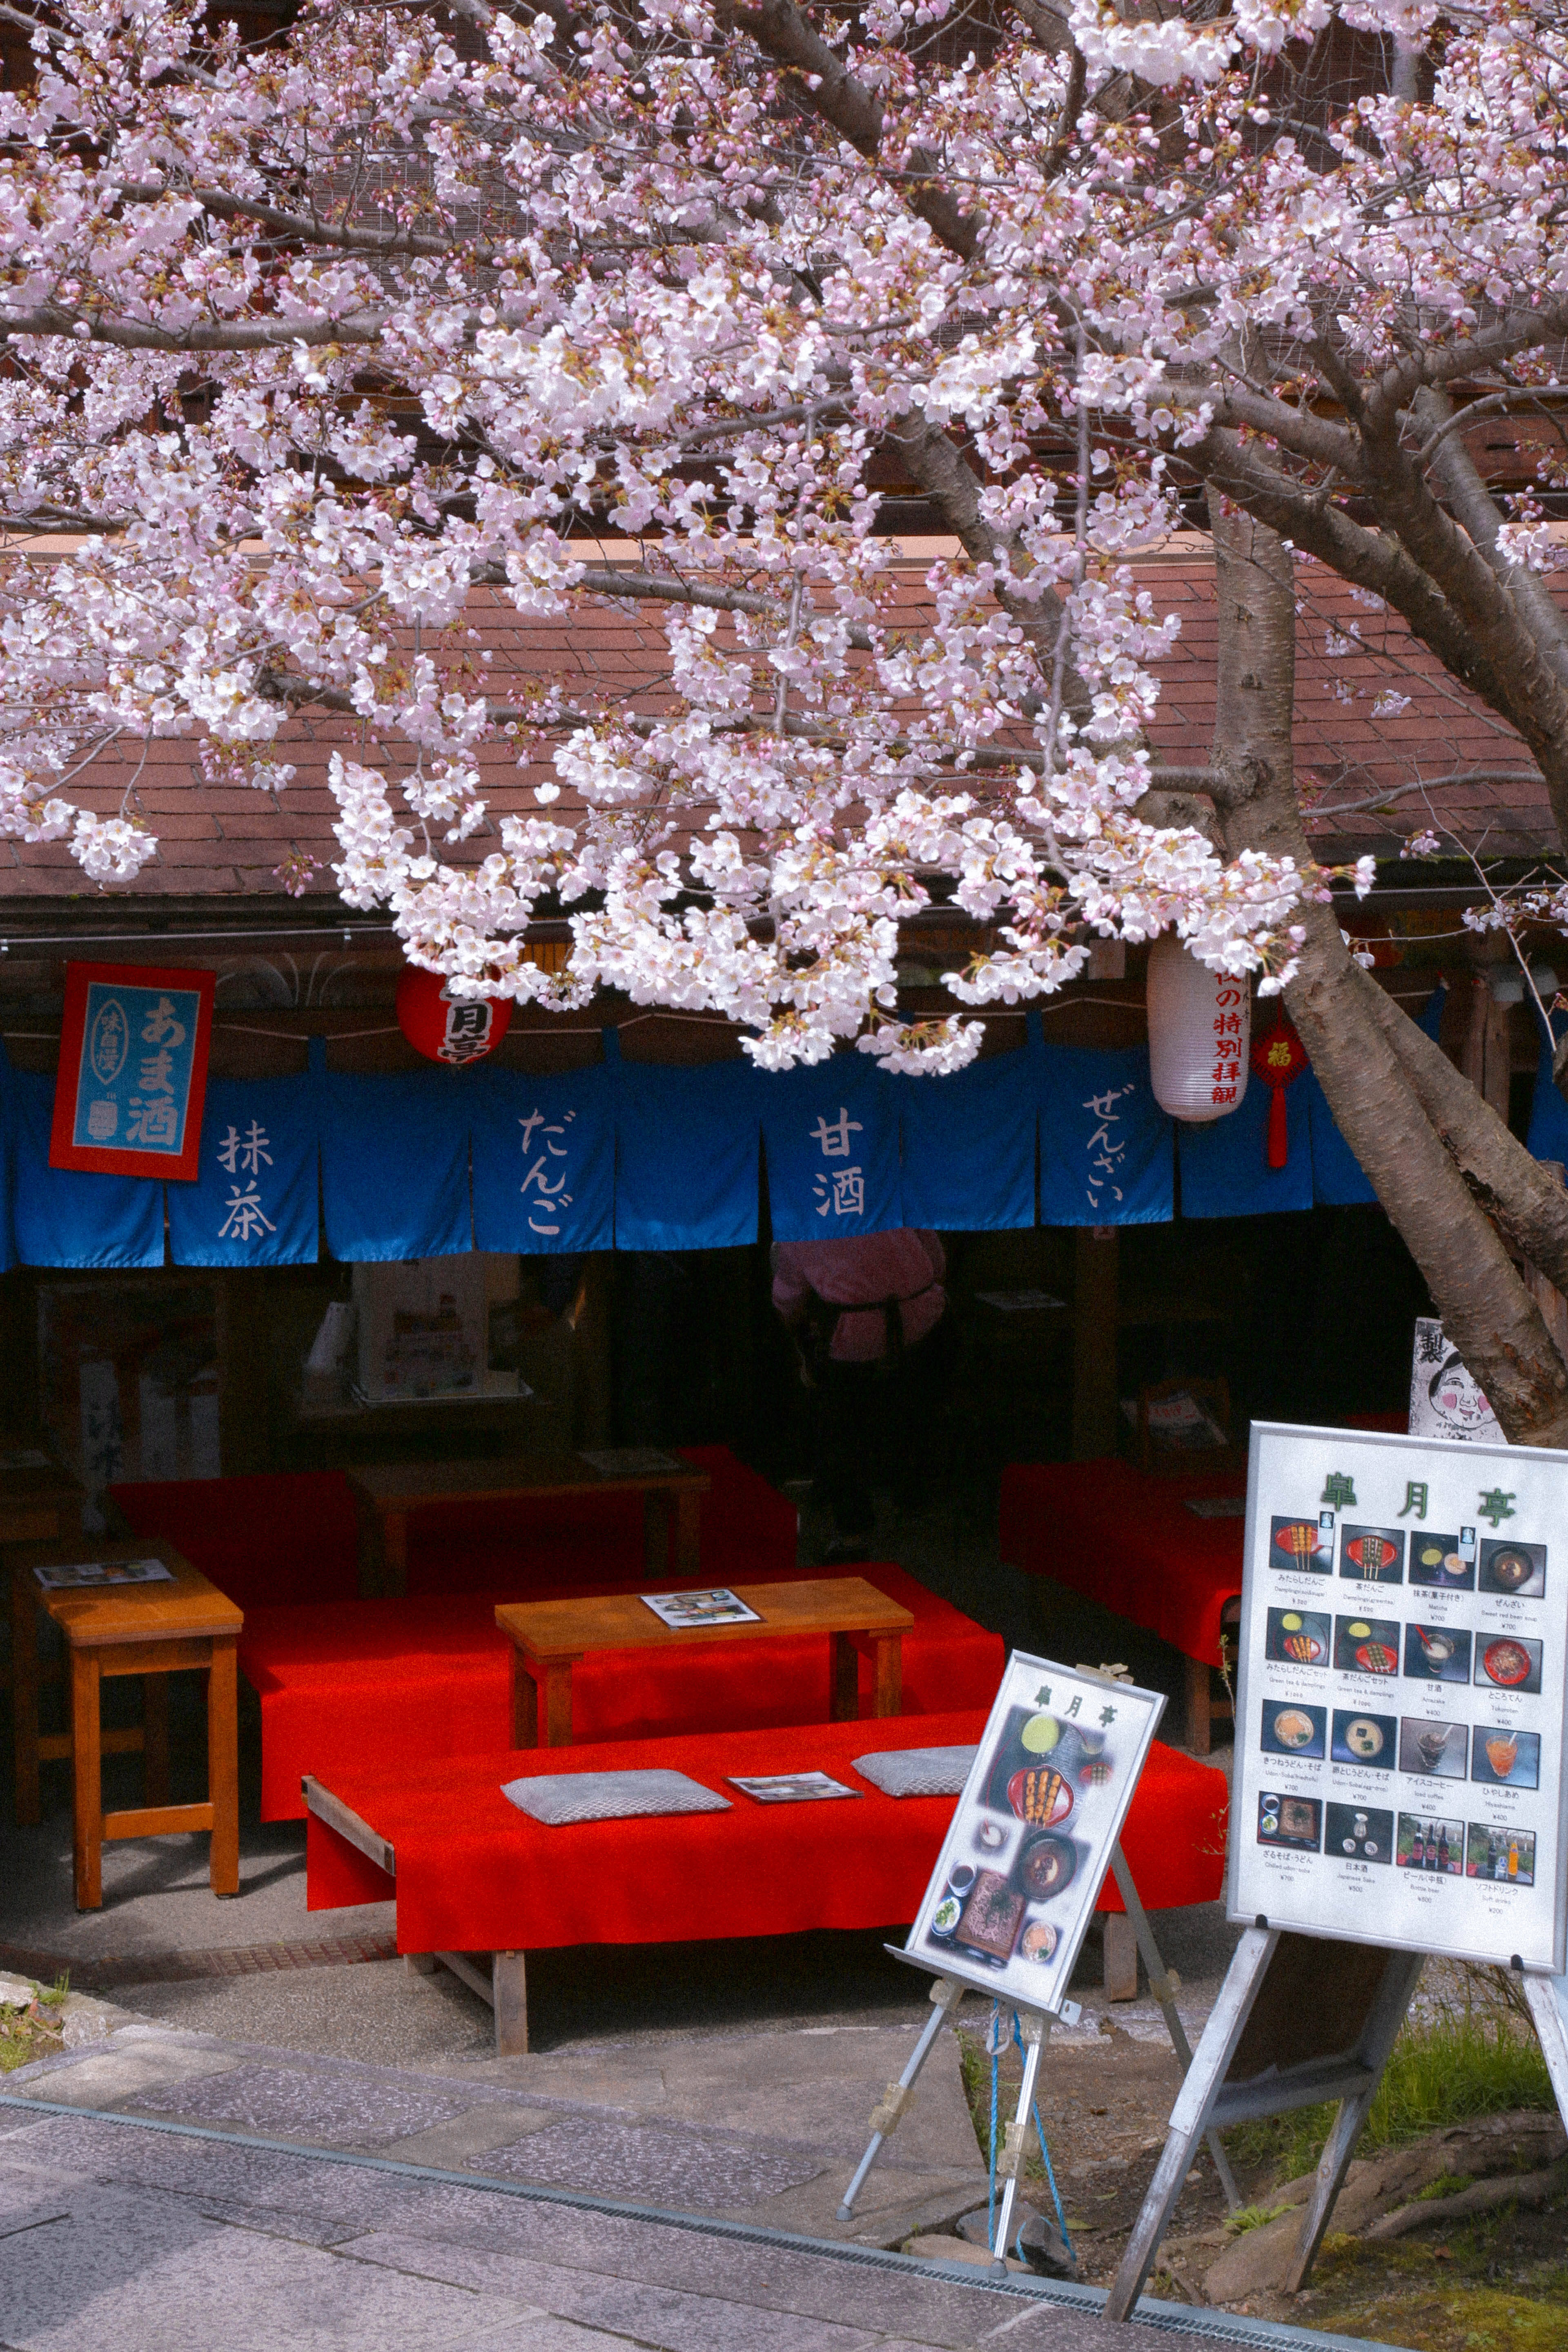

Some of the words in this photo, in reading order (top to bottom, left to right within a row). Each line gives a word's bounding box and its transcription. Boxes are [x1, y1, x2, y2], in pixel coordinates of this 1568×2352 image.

[441, 993, 488, 1062] 月亭
[96, 1011, 122, 1071] 味自慢
[1267, 1041, 1292, 1067] 福
[126, 997, 186, 1146] あま酒
[1082, 1083, 1135, 1208] ぜんざい
[809, 1107, 864, 1217] 甘酒
[518, 1107, 576, 1235] だんご
[216, 1119, 277, 1241] 抹茶
[1355, 1582, 1385, 1593] 茶だんご
[1495, 1599, 1525, 1609] ぜんざい
[1430, 1614, 1446, 1622] ¥700
[1501, 1622, 1517, 1630] ¥700
[1426, 1683, 1442, 1693] 甘酒
[1488, 1690, 1523, 1703] ところてん
[1284, 1783, 1299, 1791] ¥700
[1406, 1776, 1454, 1790] アイスコーヒー
[1482, 1787, 1520, 1800] ひやしあめ
[1345, 1862, 1368, 1873] 日本酒
[1475, 1882, 1519, 1896] ソフトドリンク
